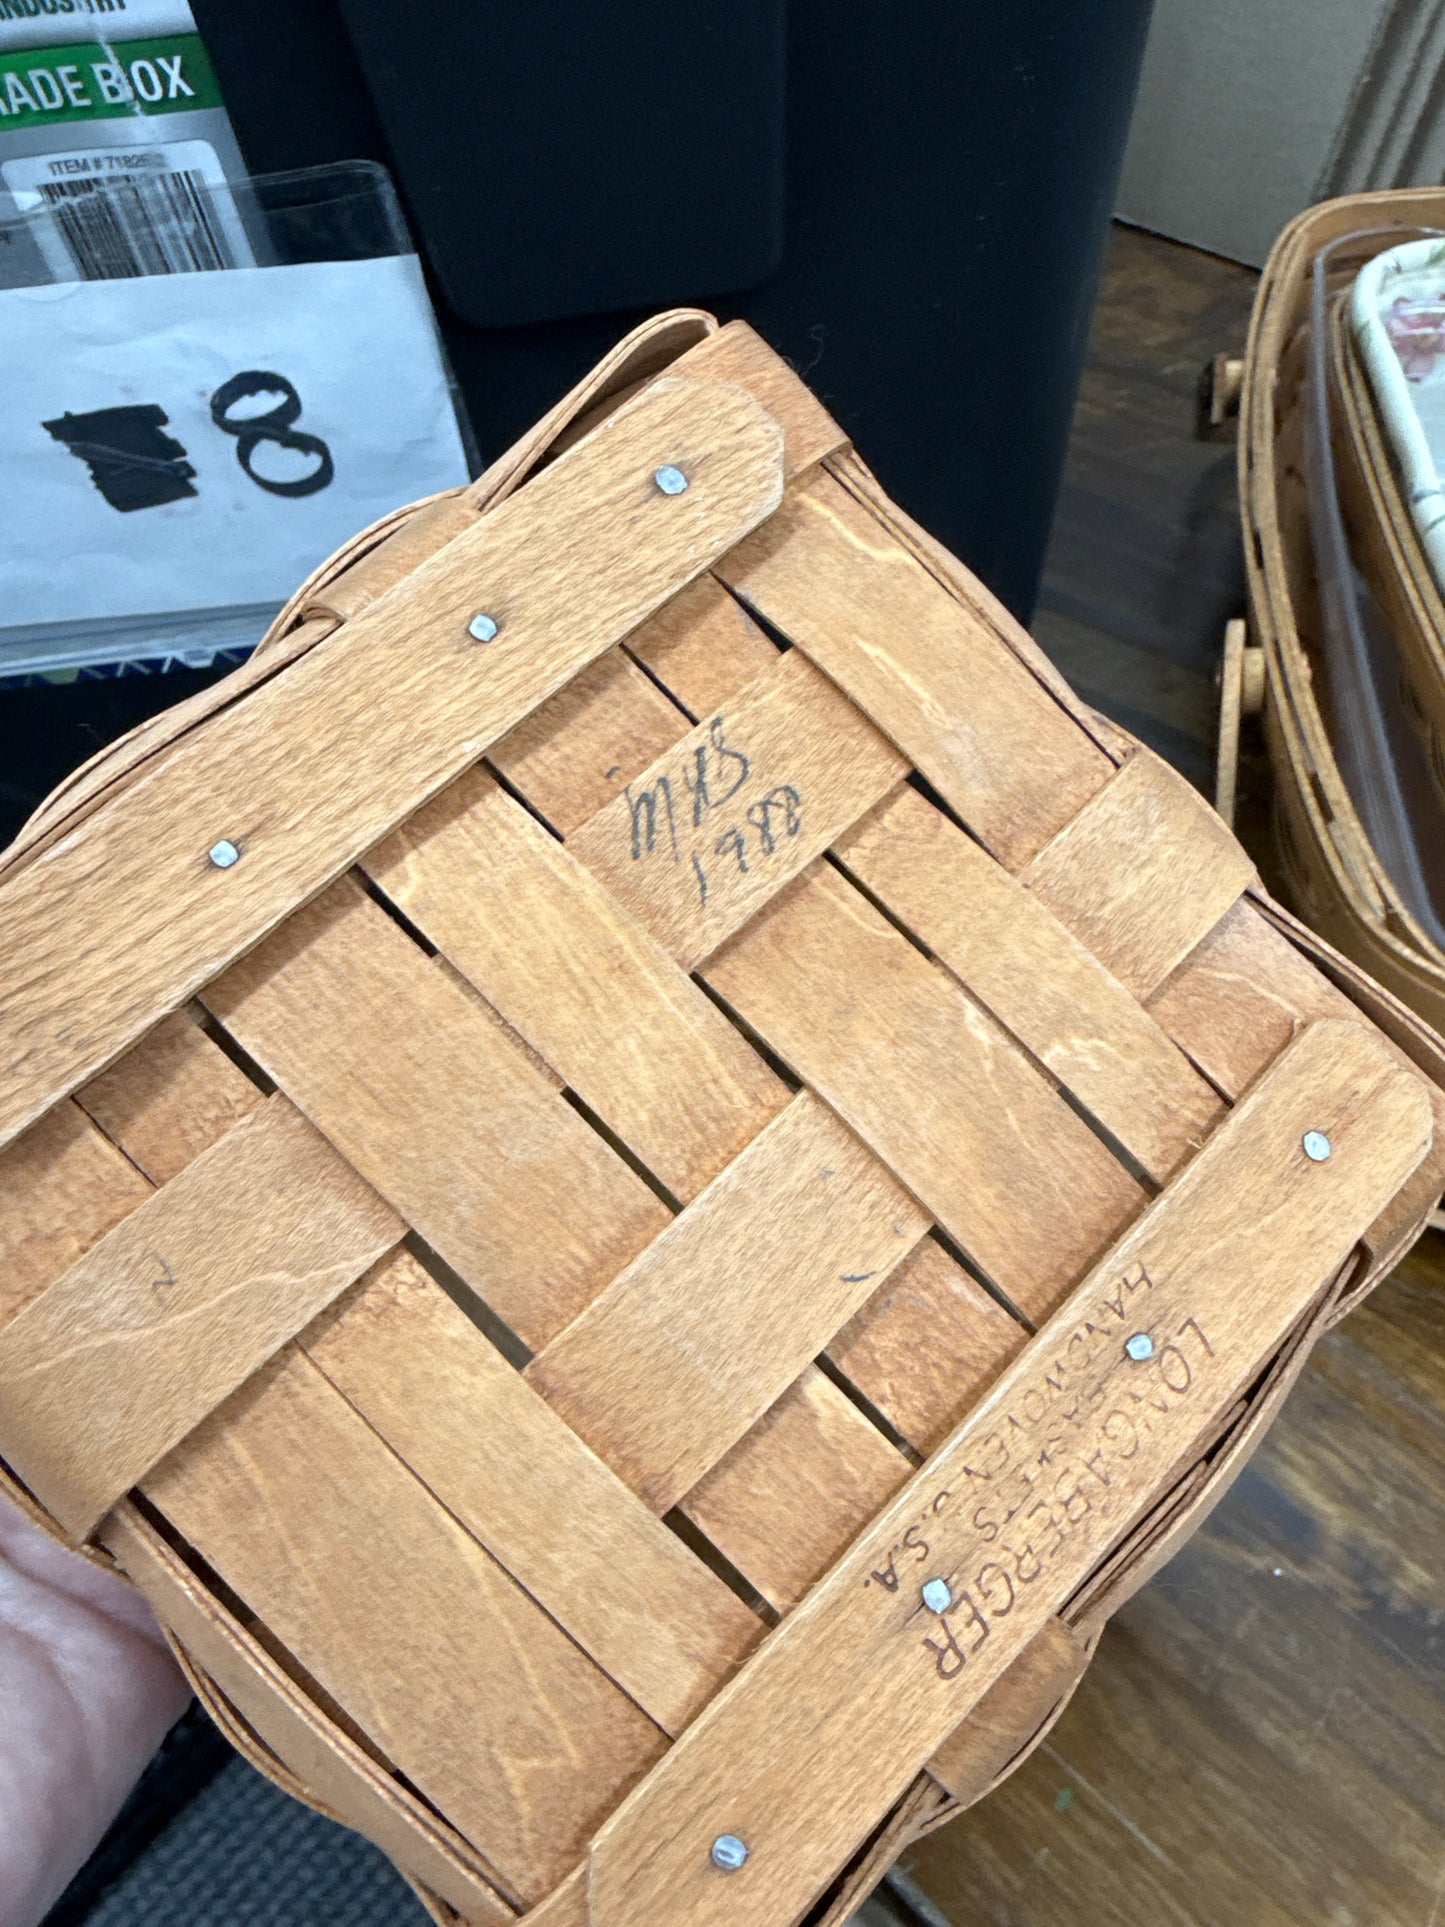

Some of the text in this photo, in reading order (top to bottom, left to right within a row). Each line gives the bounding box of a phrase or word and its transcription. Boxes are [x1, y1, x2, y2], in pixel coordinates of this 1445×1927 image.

[0, 55, 196, 116] ADE BOX
[48, 158, 92, 177] ITEM
[210, 370, 334, 498] 8
[692, 784, 802, 909] 1988
[864, 1259, 1153, 1594] HANDWOVEN U.S.A.
[922, 1316, 1216, 1680] LONGABERGER
